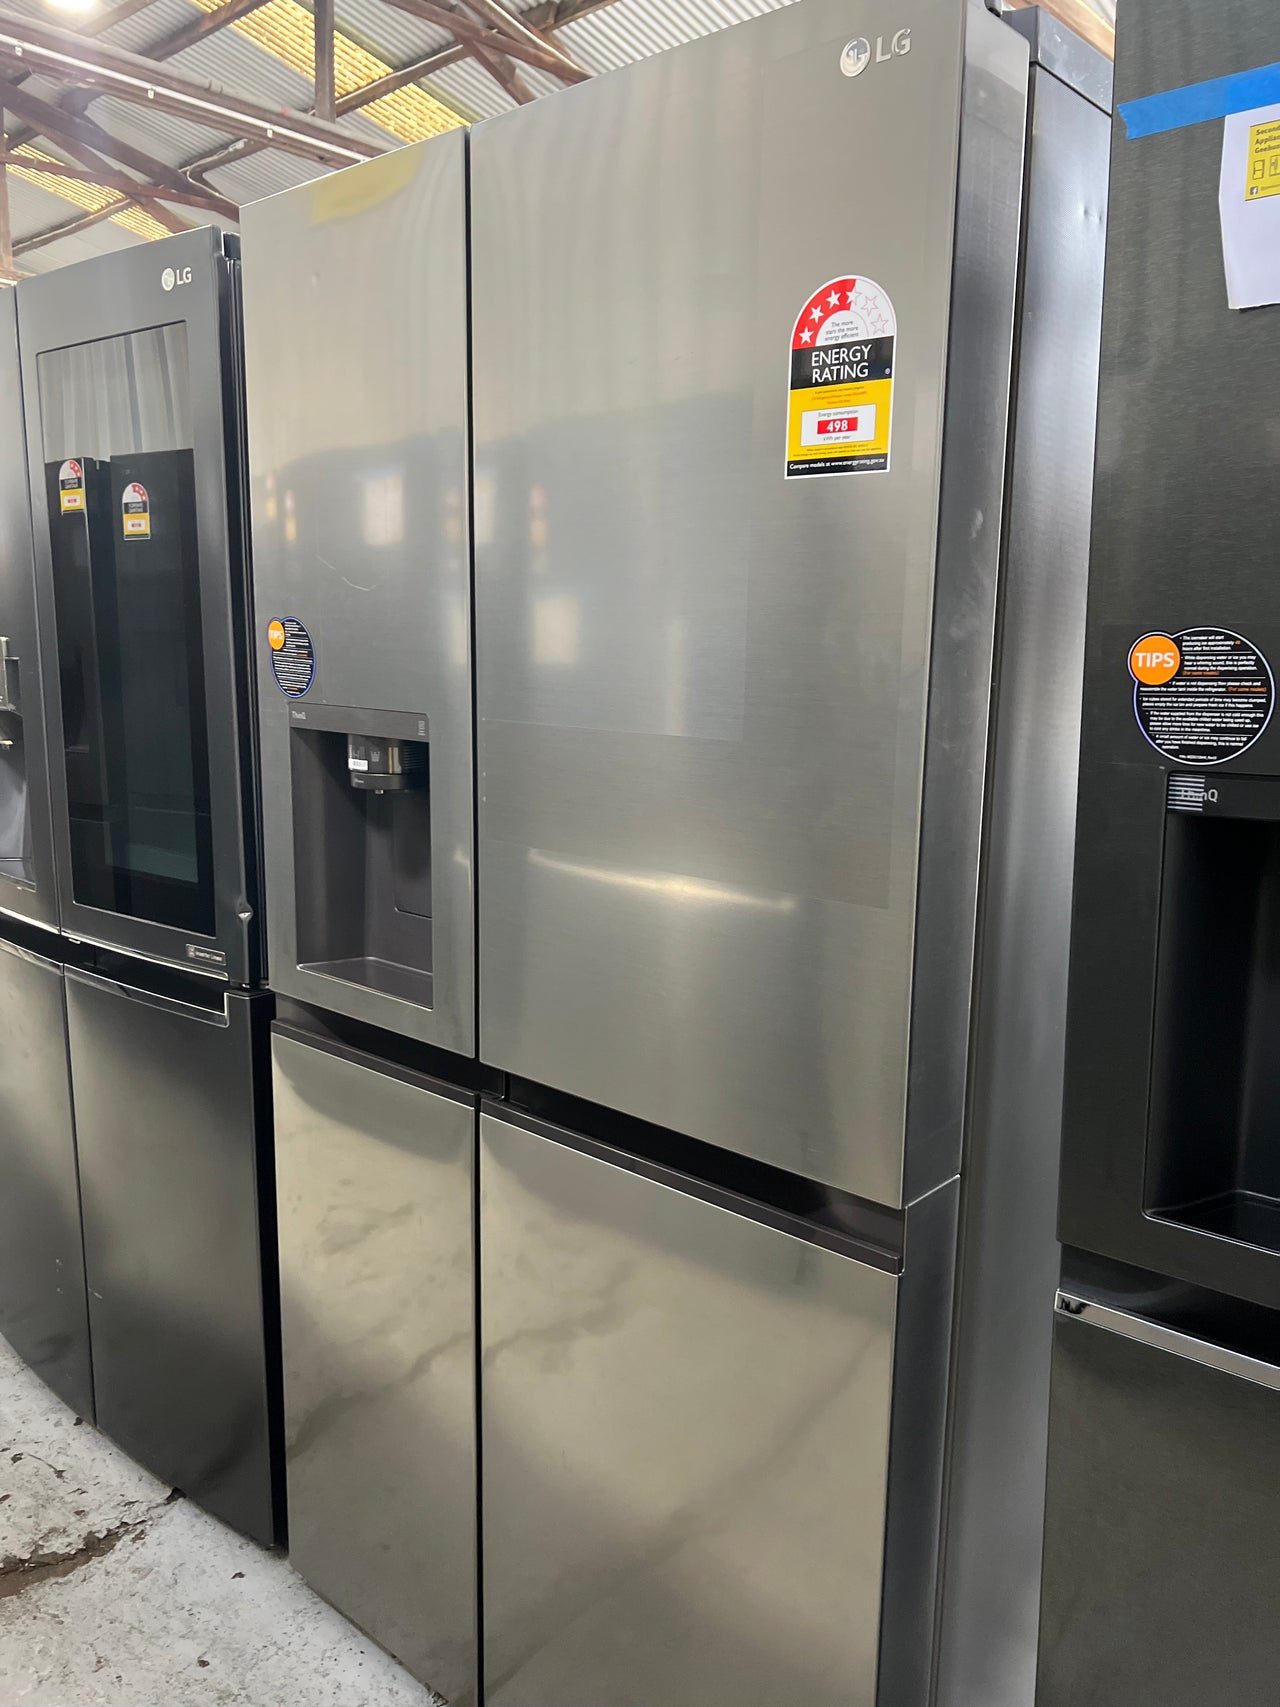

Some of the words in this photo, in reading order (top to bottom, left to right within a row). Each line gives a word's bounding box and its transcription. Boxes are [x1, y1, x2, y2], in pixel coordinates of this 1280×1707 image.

[875, 28, 911, 63] LG
[176, 267, 192, 285] LG
[811, 344, 872, 367] ENERGY
[812, 362, 869, 384] RATING
[826, 419, 848, 432] 498
[1135, 652, 1175, 668] TIPS
